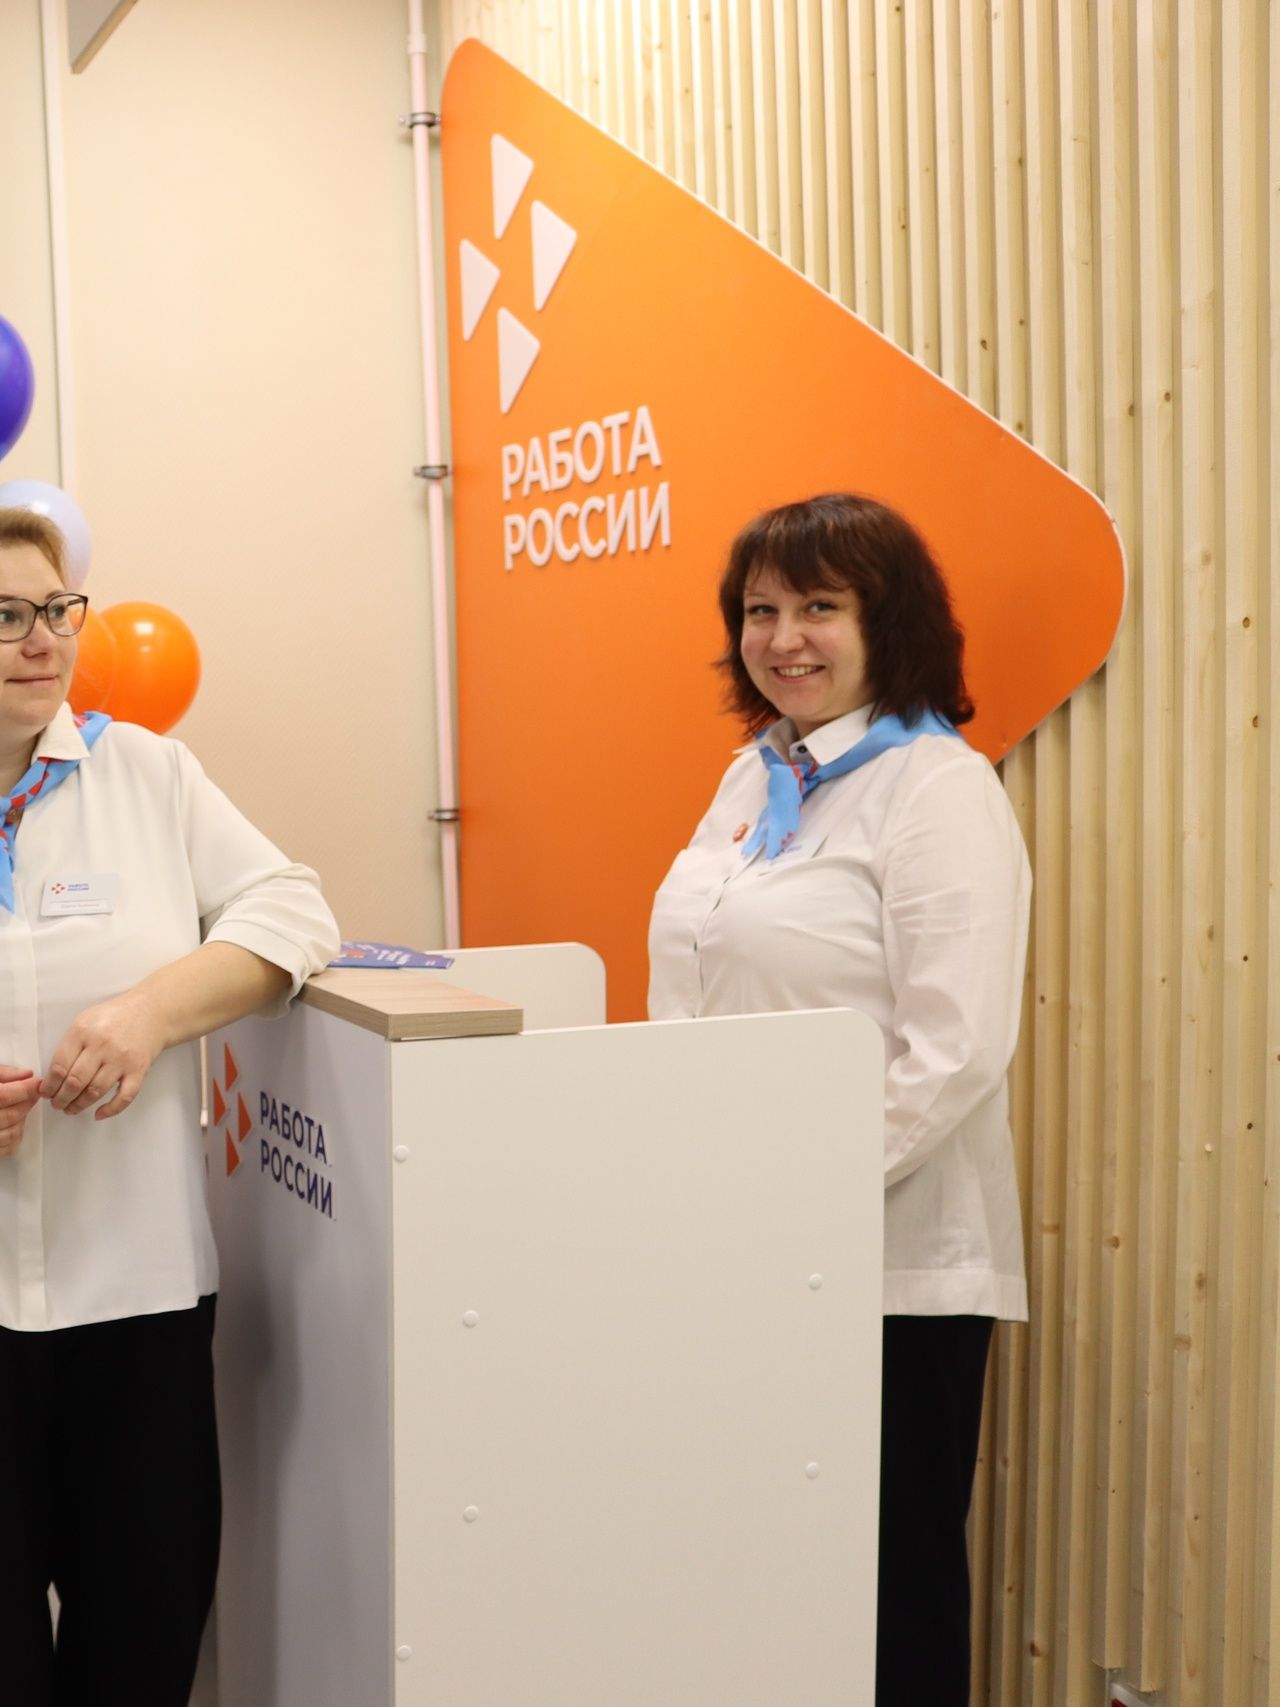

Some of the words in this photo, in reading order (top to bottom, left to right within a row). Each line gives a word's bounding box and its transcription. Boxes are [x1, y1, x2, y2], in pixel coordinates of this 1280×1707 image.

[501, 405, 662, 501] РАБОТА
[503, 481, 671, 571] РОССИИ
[260, 1091, 328, 1164] РАБОТА
[261, 1139, 333, 1219] РОССИИ
